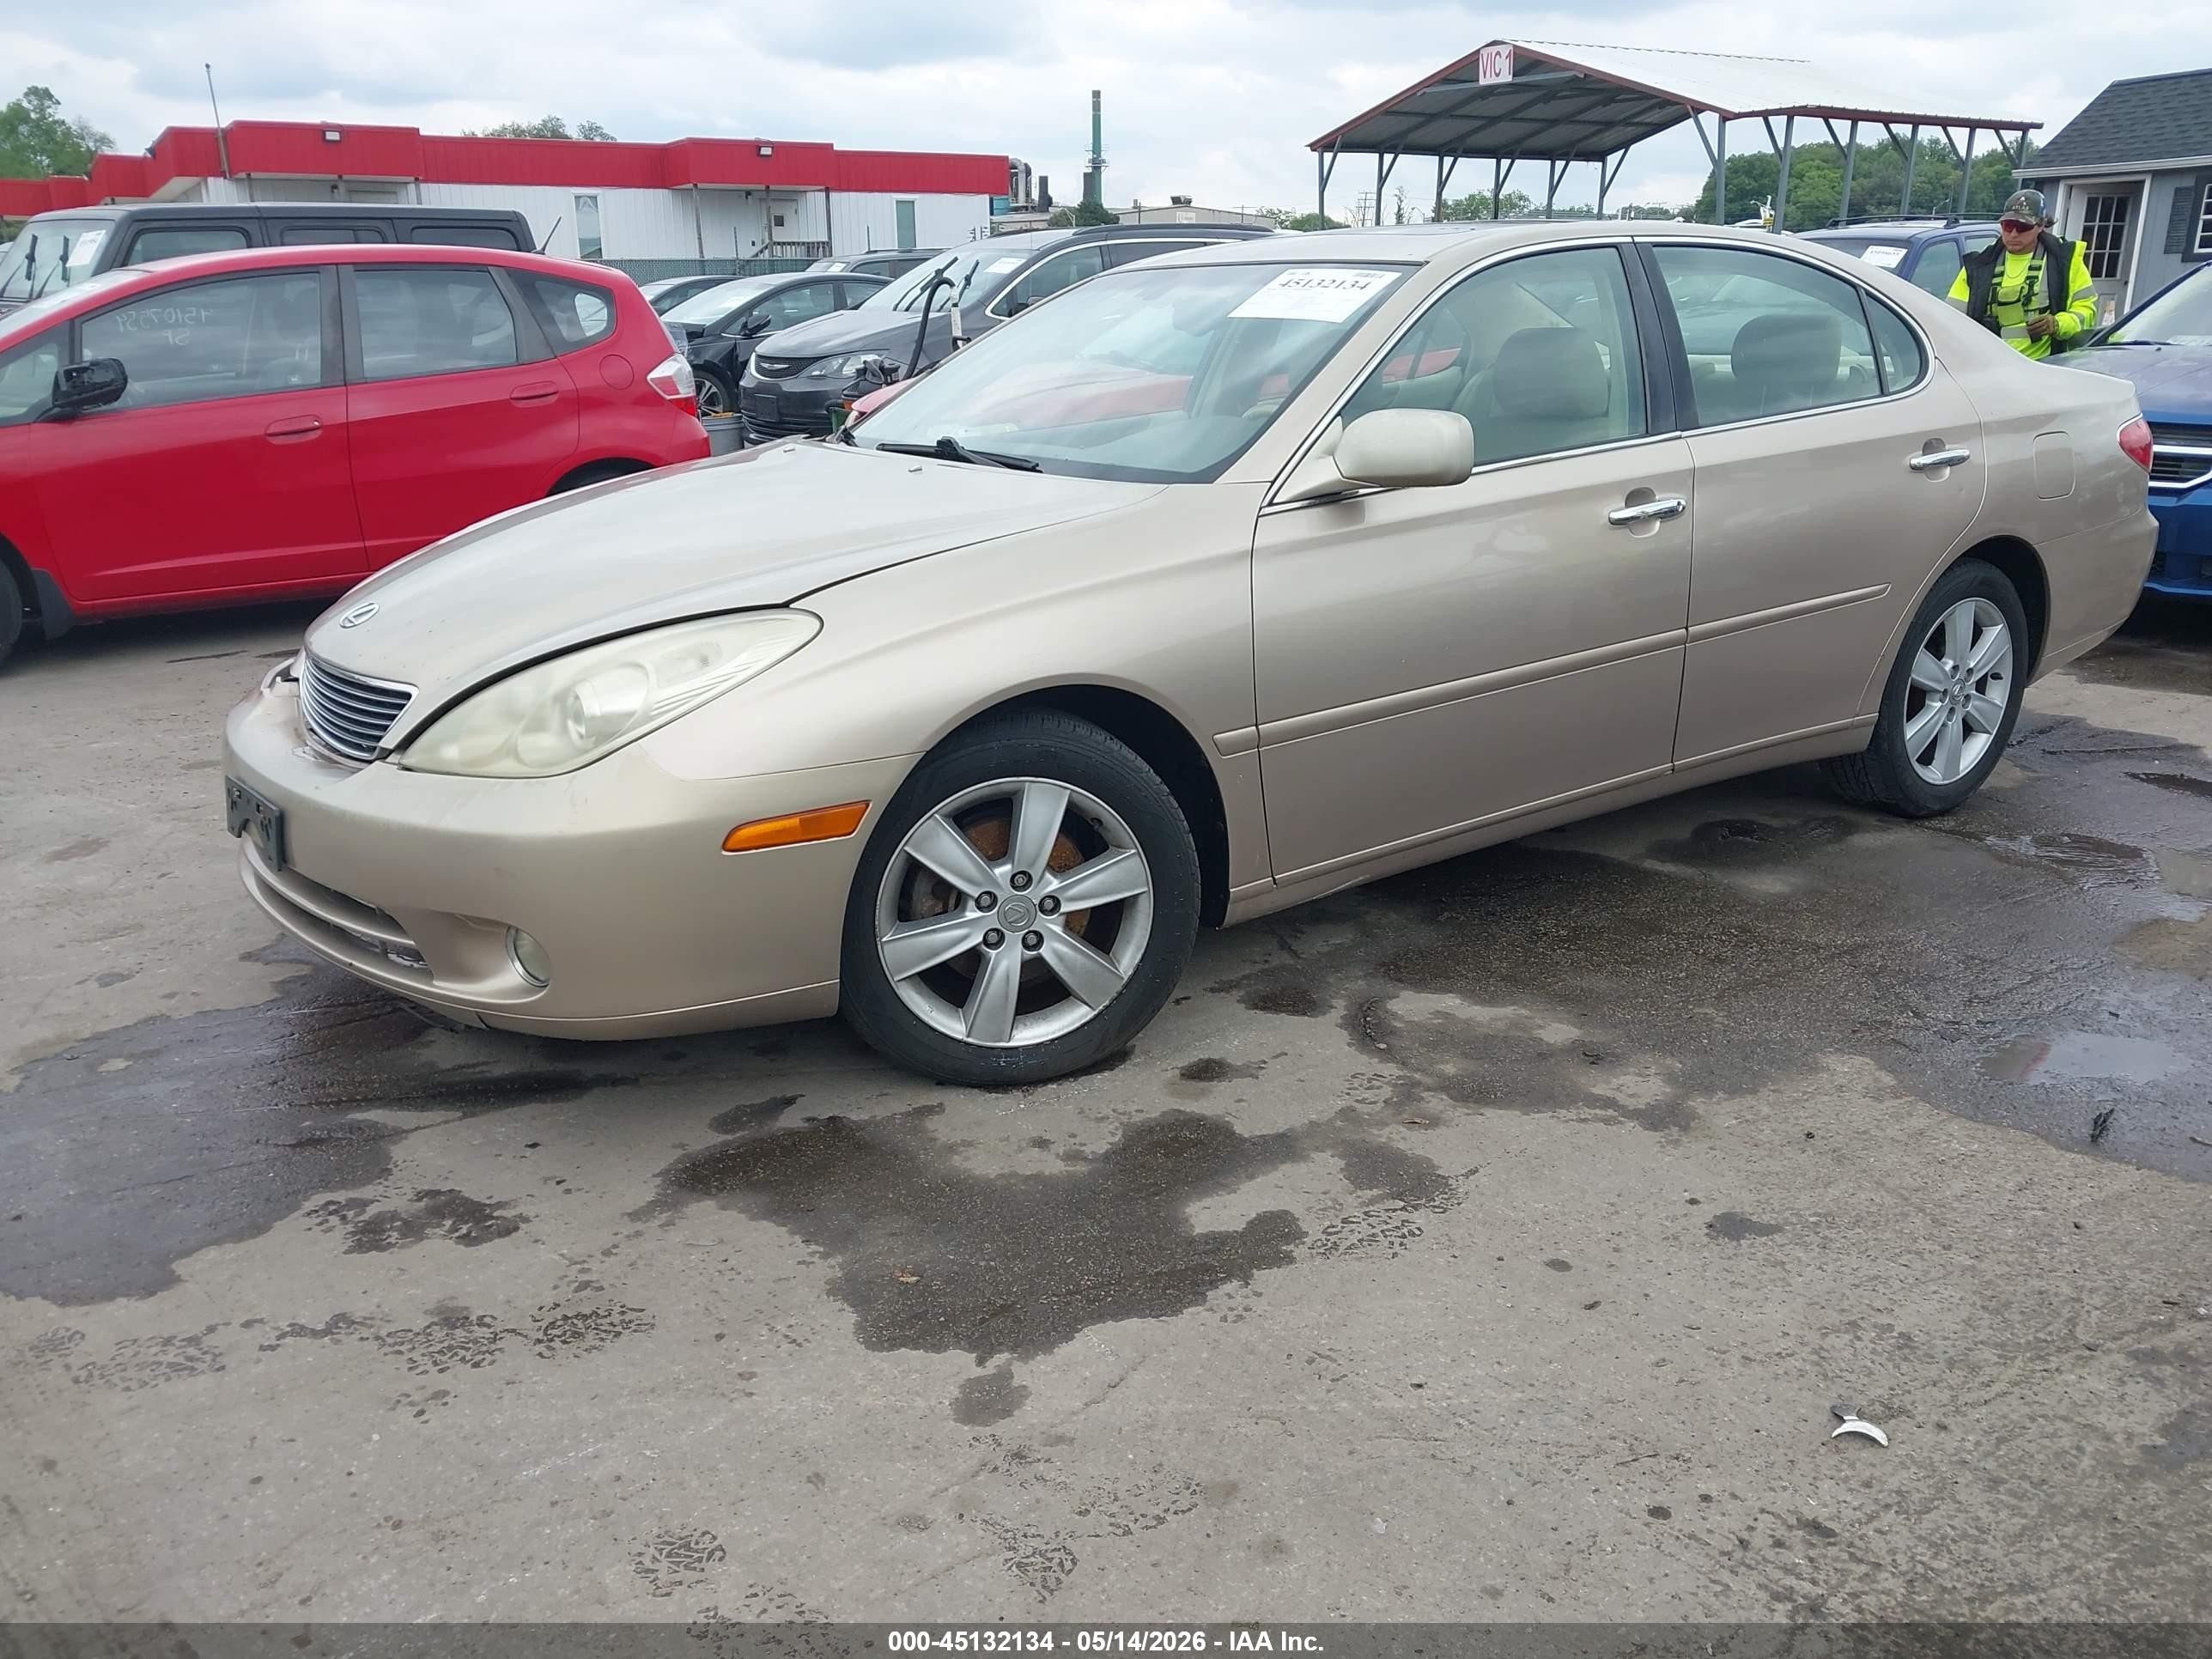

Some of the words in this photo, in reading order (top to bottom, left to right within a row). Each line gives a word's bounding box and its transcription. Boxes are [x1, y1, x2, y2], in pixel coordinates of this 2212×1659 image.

[1480, 51, 1502, 78] VIC
[1505, 49, 1512, 76] 1
[1279, 278, 1372, 290] 45132134
